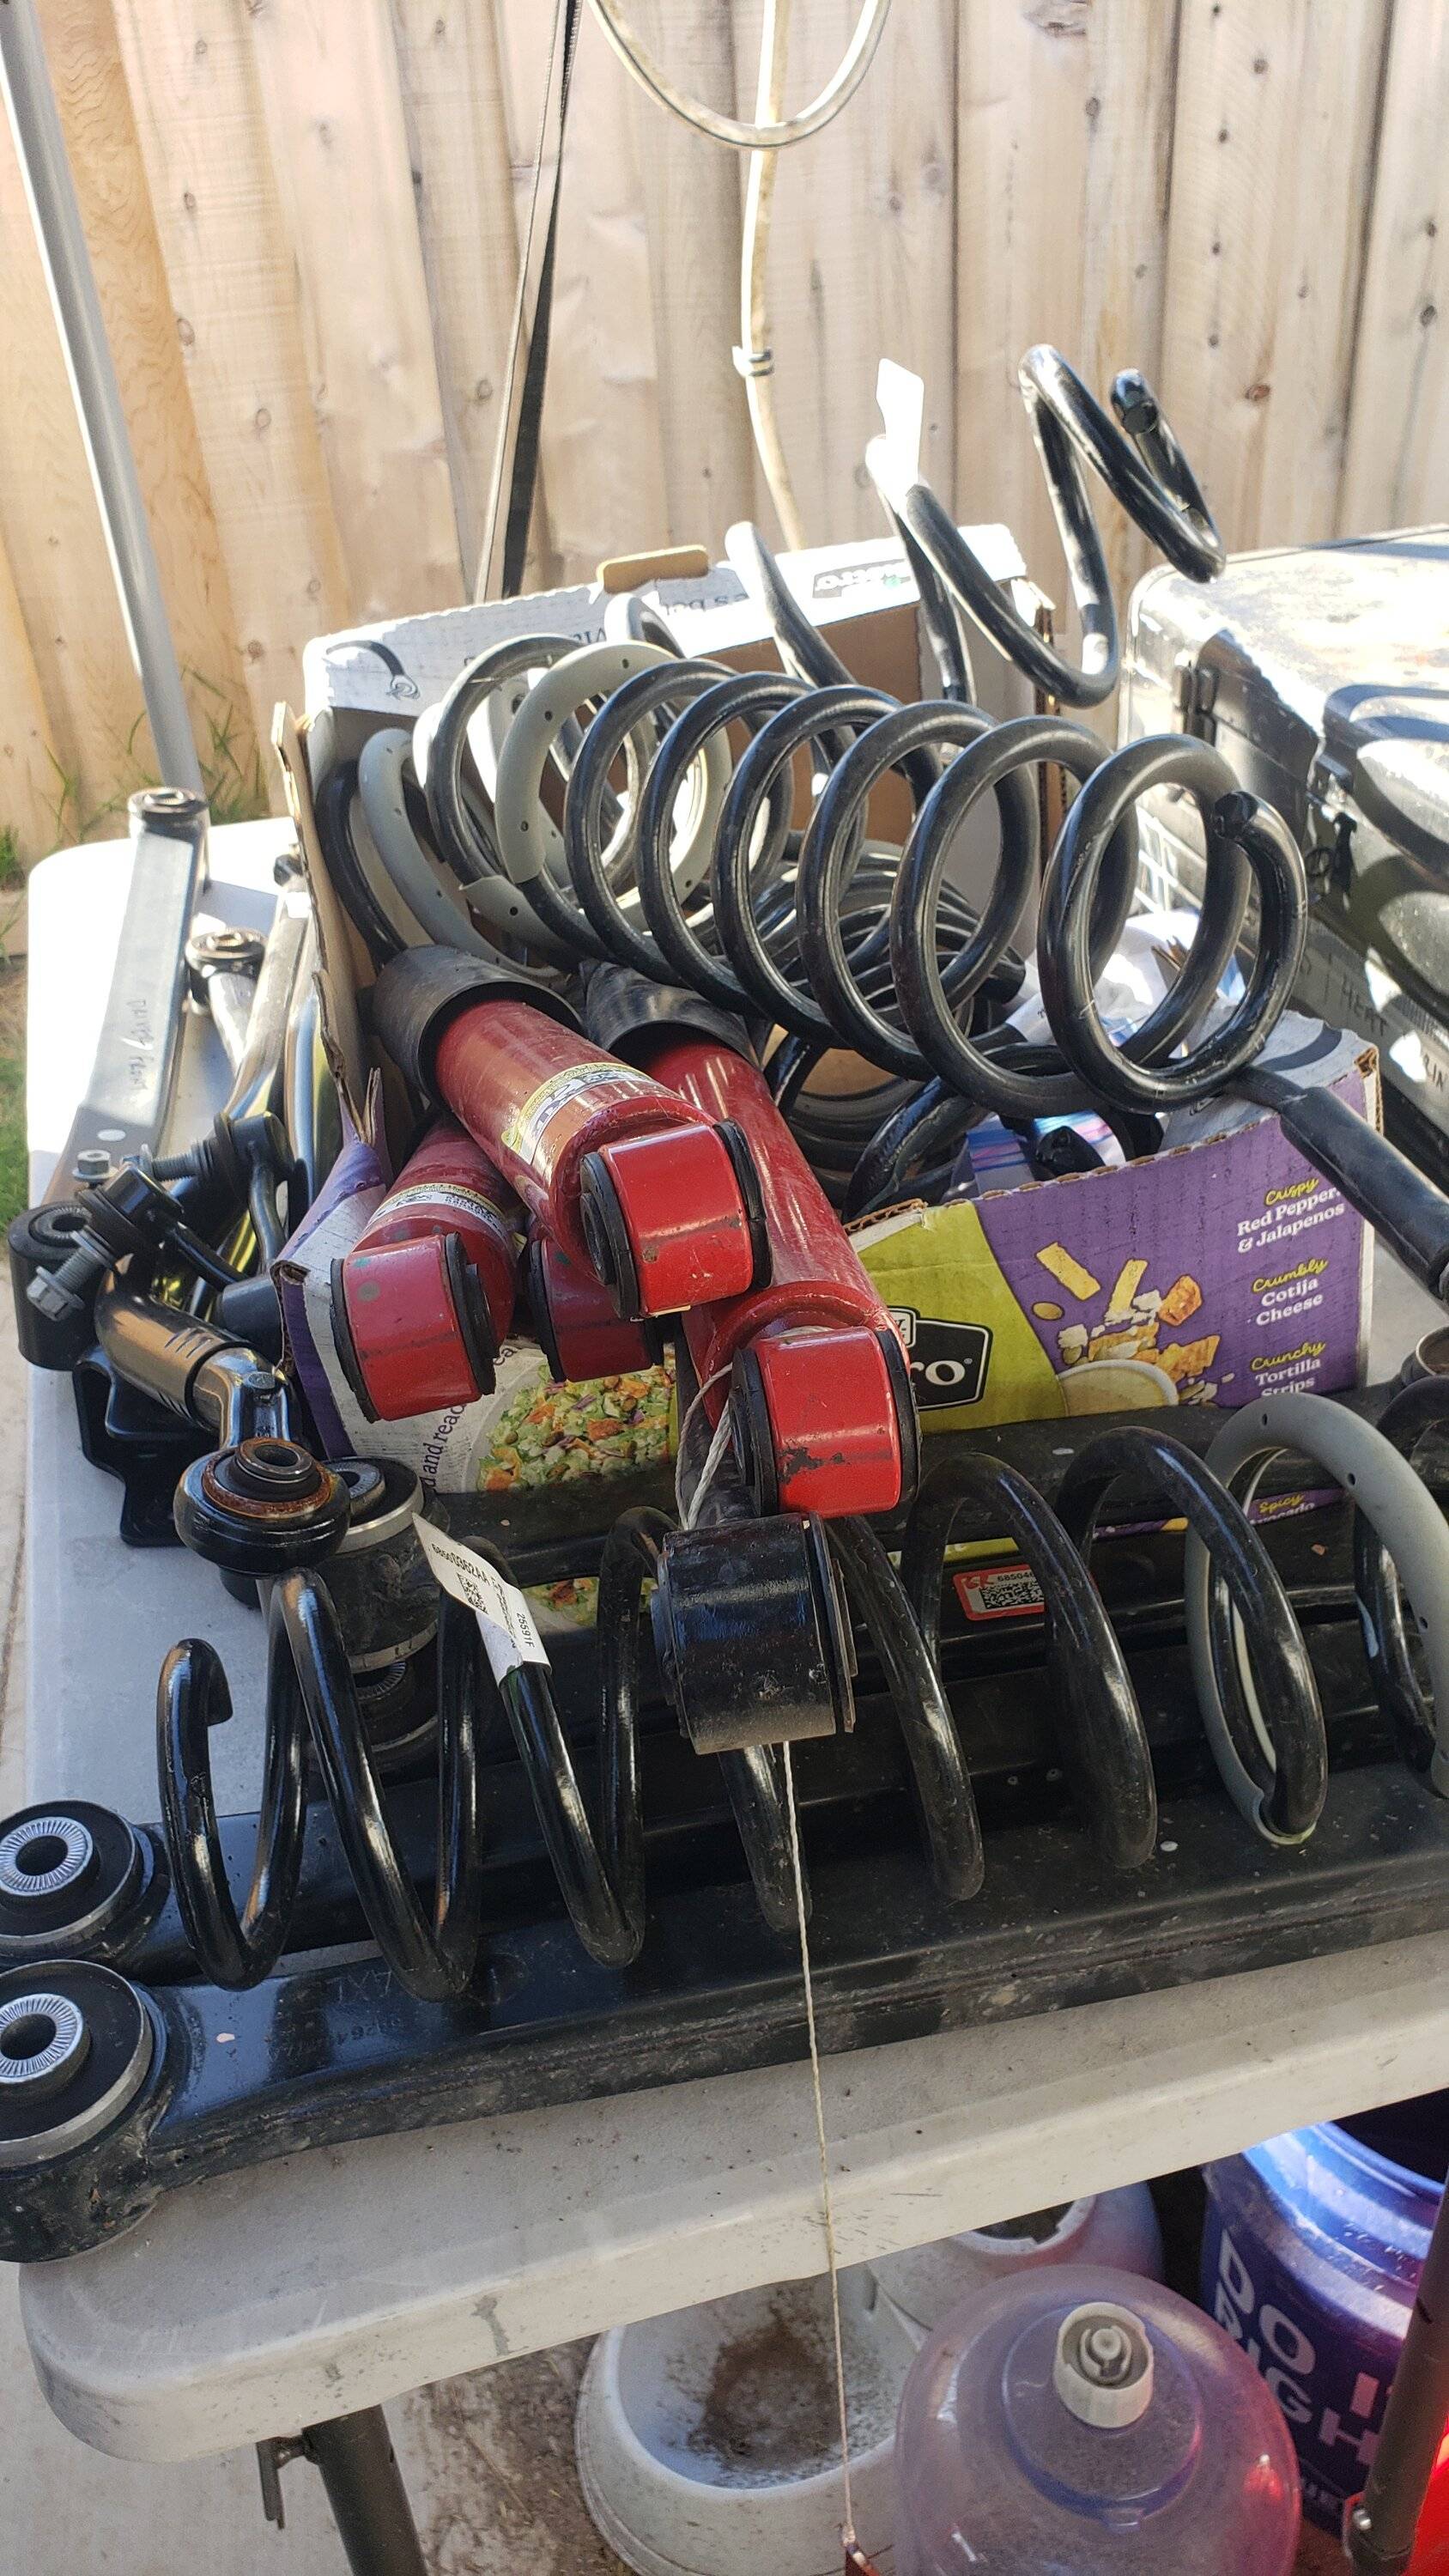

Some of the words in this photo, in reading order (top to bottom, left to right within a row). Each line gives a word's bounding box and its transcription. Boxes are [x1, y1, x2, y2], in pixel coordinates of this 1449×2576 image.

[1264, 1178, 1319, 1206] Crispy
[1237, 1210, 1272, 1236] Red
[1238, 1236, 1253, 1254] &
[1256, 1203, 1345, 1247] Jalapenos
[1253, 1258, 1329, 1292] Crumbly
[1261, 1278, 1319, 1307] Cotija
[1256, 1294, 1324, 1326] Cheese
[1252, 1341, 1326, 1371] Crunchy
[1255, 1358, 1321, 1386] Tortilla
[423, 1443, 444, 1474] and
[1259, 1494, 1305, 1514] Spicy
[1219, 2229, 1317, 2377] DO
